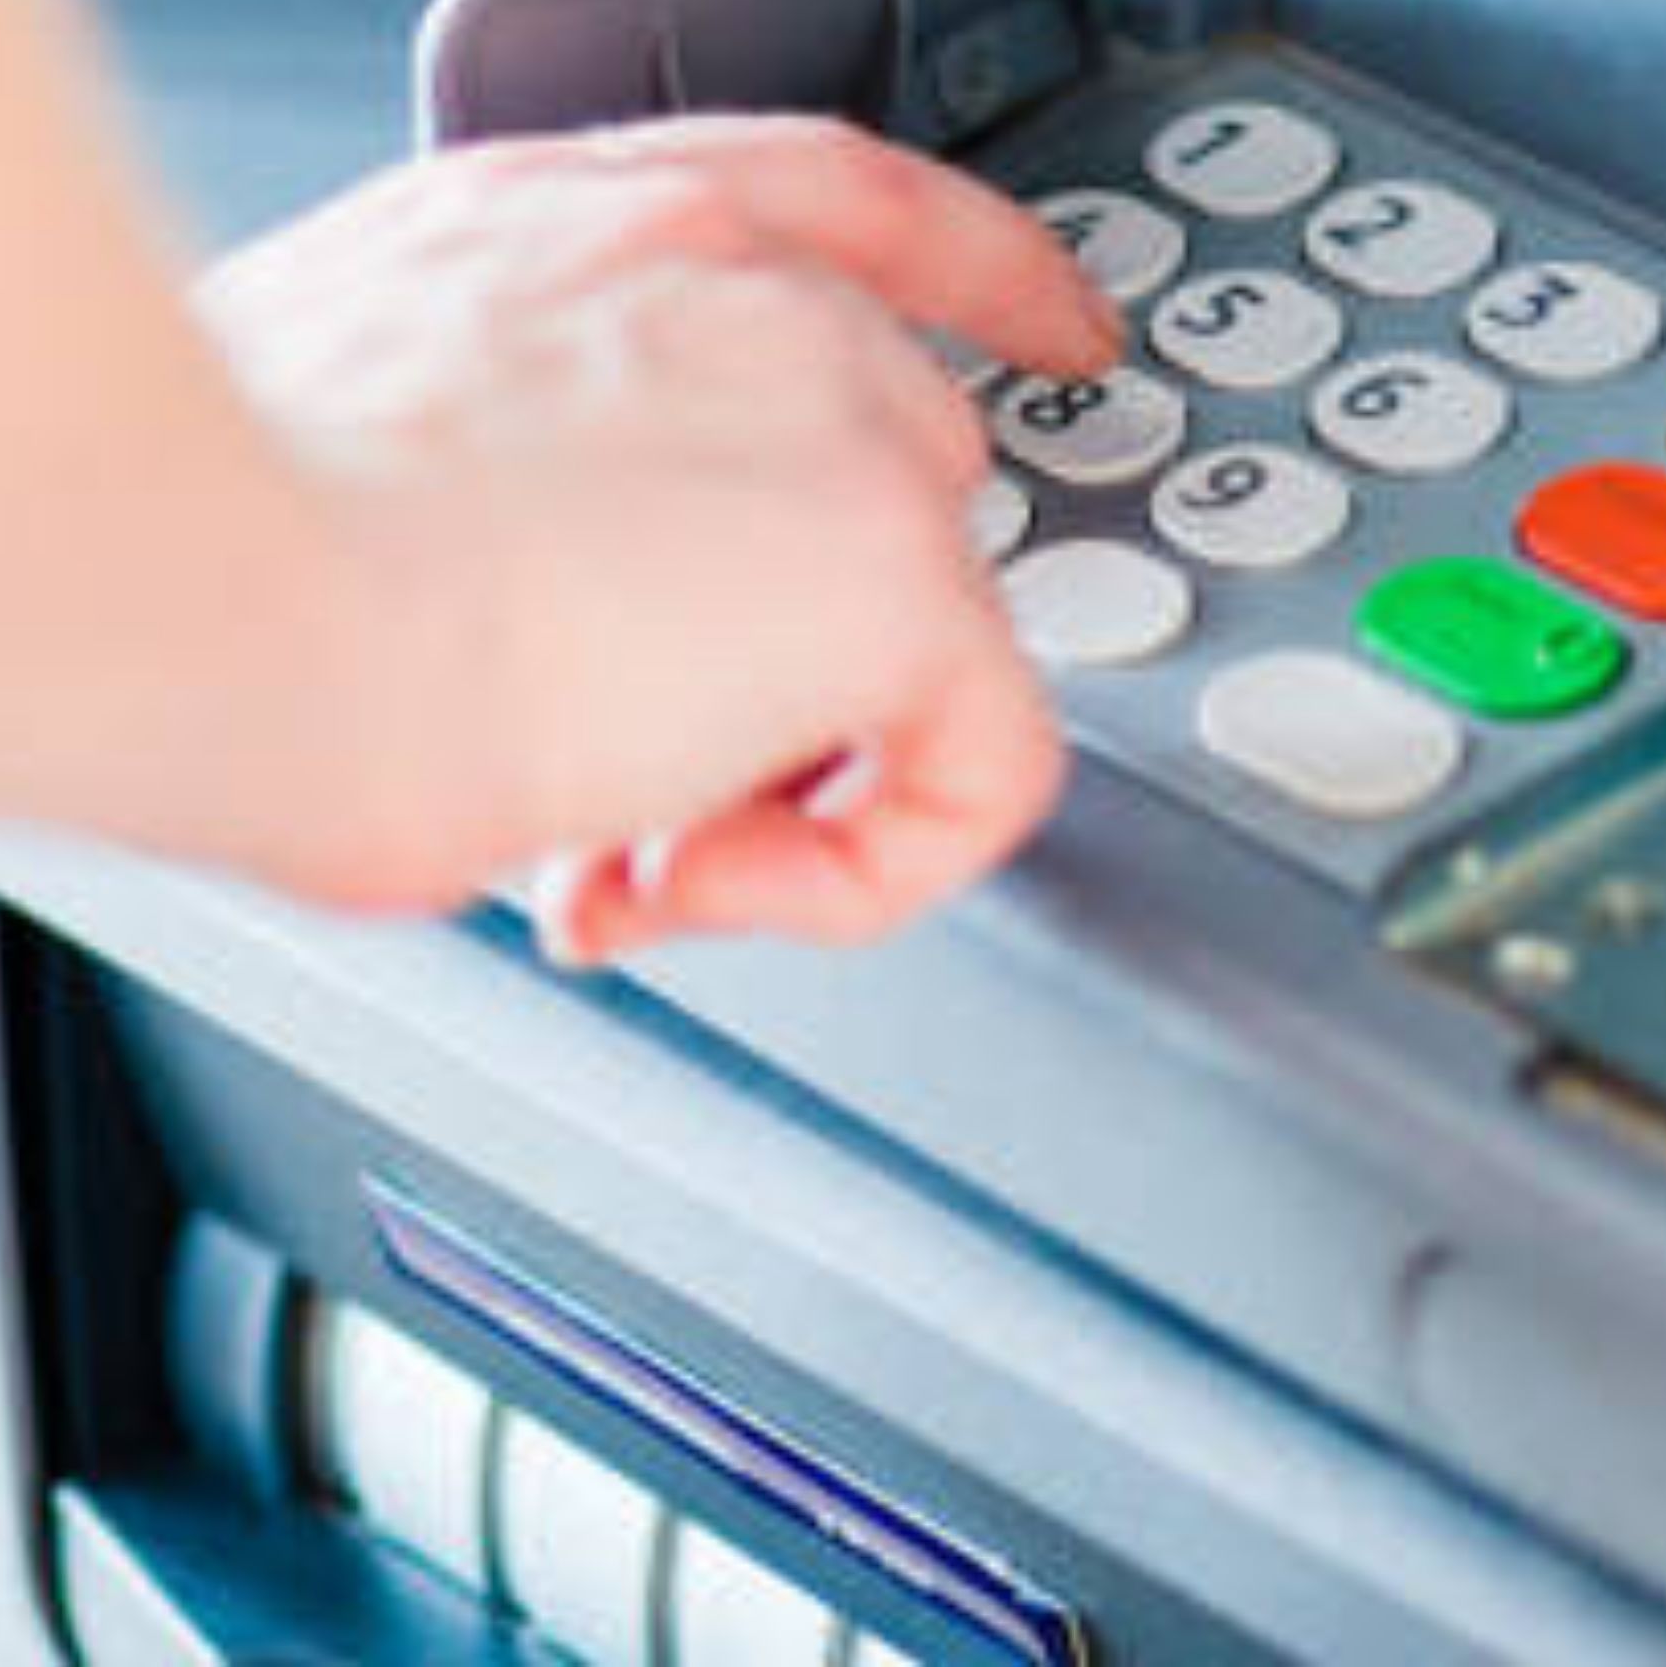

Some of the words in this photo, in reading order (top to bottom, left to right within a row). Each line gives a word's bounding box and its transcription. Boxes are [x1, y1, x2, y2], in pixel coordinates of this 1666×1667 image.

[1180, 120, 1247, 164] 1
[1323, 196, 1414, 247] 2
[1175, 284, 1267, 336] 5
[1479, 274, 1581, 328] 3
[1019, 380, 1107, 431] 8
[1339, 370, 1432, 419] 6
[1176, 456, 1269, 508] 9
